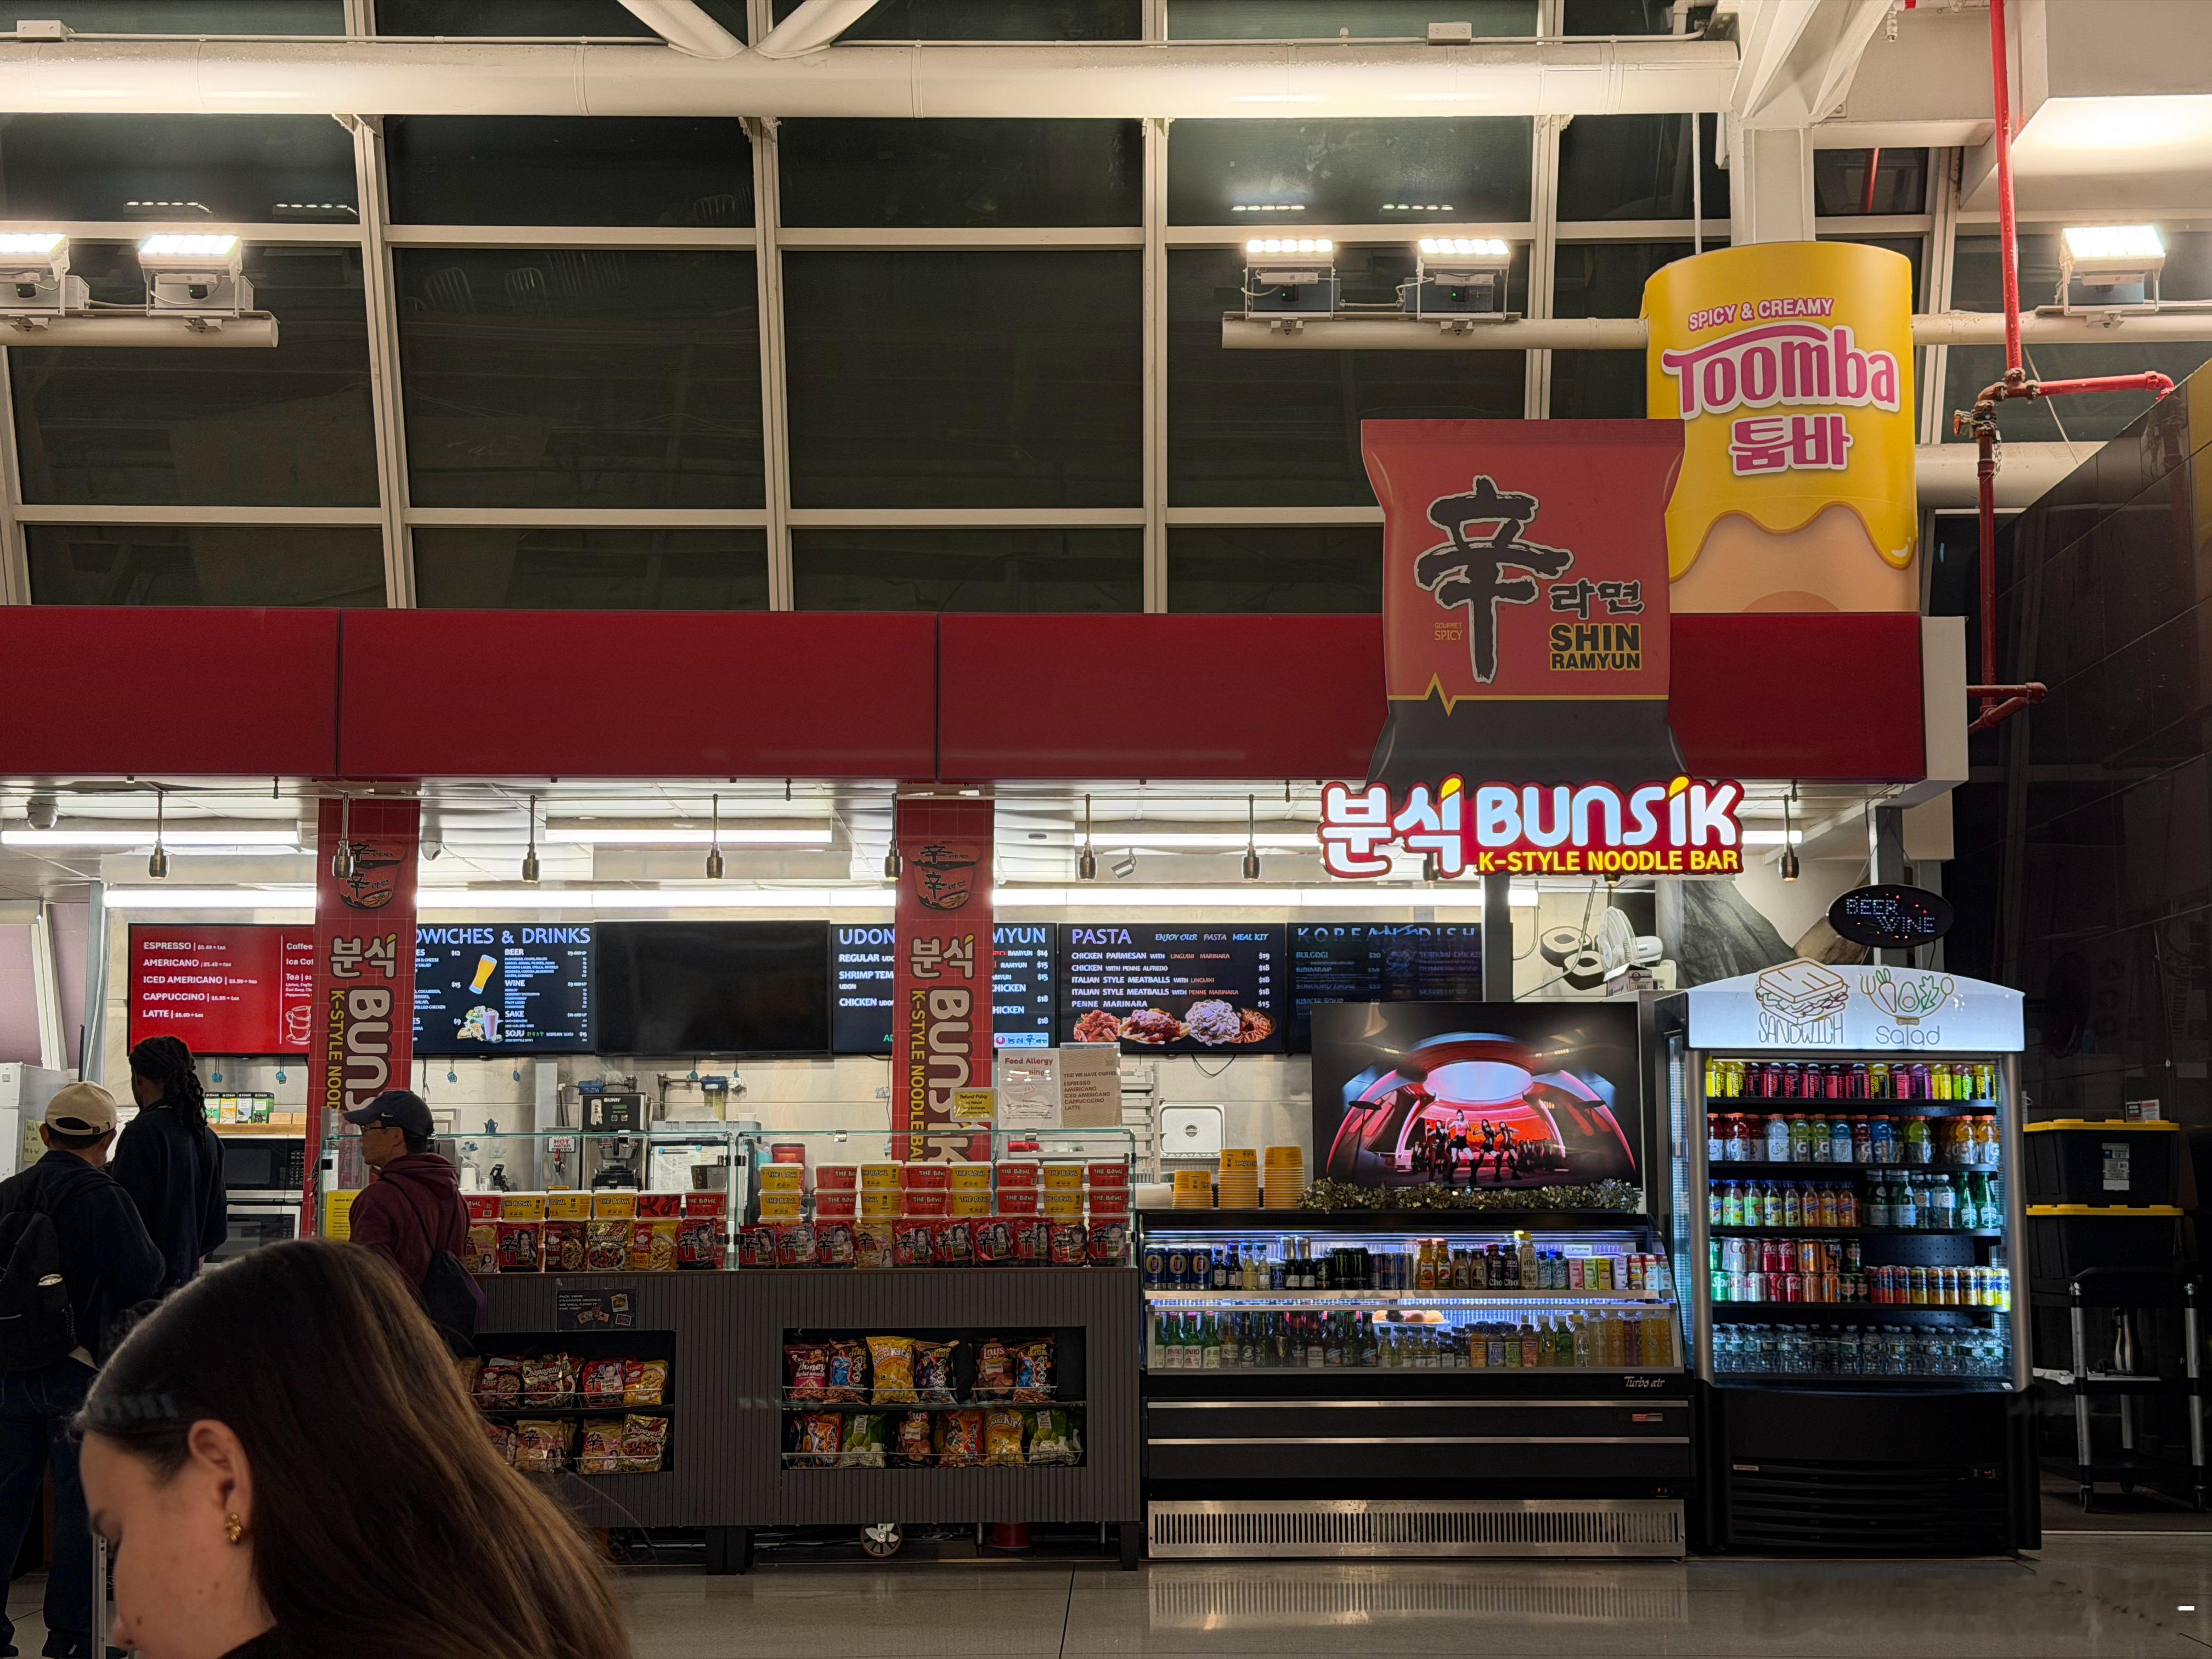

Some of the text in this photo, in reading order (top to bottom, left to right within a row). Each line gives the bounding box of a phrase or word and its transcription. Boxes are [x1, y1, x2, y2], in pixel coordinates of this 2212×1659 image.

[1689, 297, 1835, 331] SPICY & CREAMY
[1662, 324, 1895, 414] Toomba
[1730, 415, 1850, 472] 툼바
[1414, 476, 1573, 684] 辛
[1549, 578, 1645, 619] 라면
[1434, 630, 1463, 641] SPICY
[1550, 624, 1640, 652] SHIN
[1551, 653, 1640, 670] RAMYUN
[1323, 777, 1462, 873] 분식
[1479, 850, 1738, 873] K-STYLE NOODLE BAR
[1846, 899, 1898, 915] BEER
[1876, 916, 1936, 932] WINE
[501, 930, 515, 944] &
[522, 928, 591, 944] DRINKS
[839, 928, 895, 945] UDON
[1071, 929, 1132, 945] PASTA
[330, 934, 397, 978] 분식
[839, 953, 879, 962] REGULAR
[911, 934, 975, 979] 분식
[1036, 961, 1048, 969] $15
[839, 970, 873, 980] SHRIMP
[1037, 973, 1048, 981] $15
[839, 998, 877, 1007] CHICKEN
[143, 1009, 169, 1018] LATTE
[328, 990, 345, 1061] K-STYLE
[910, 990, 926, 1059] K-STYLE
[1757, 1012, 1940, 1046] SANDWICH Salad
[1025, 1057, 1054, 1065] Allergy
[909, 1063, 926, 1130] NOODLE
[1623, 1376, 1666, 1387] Turbo air
